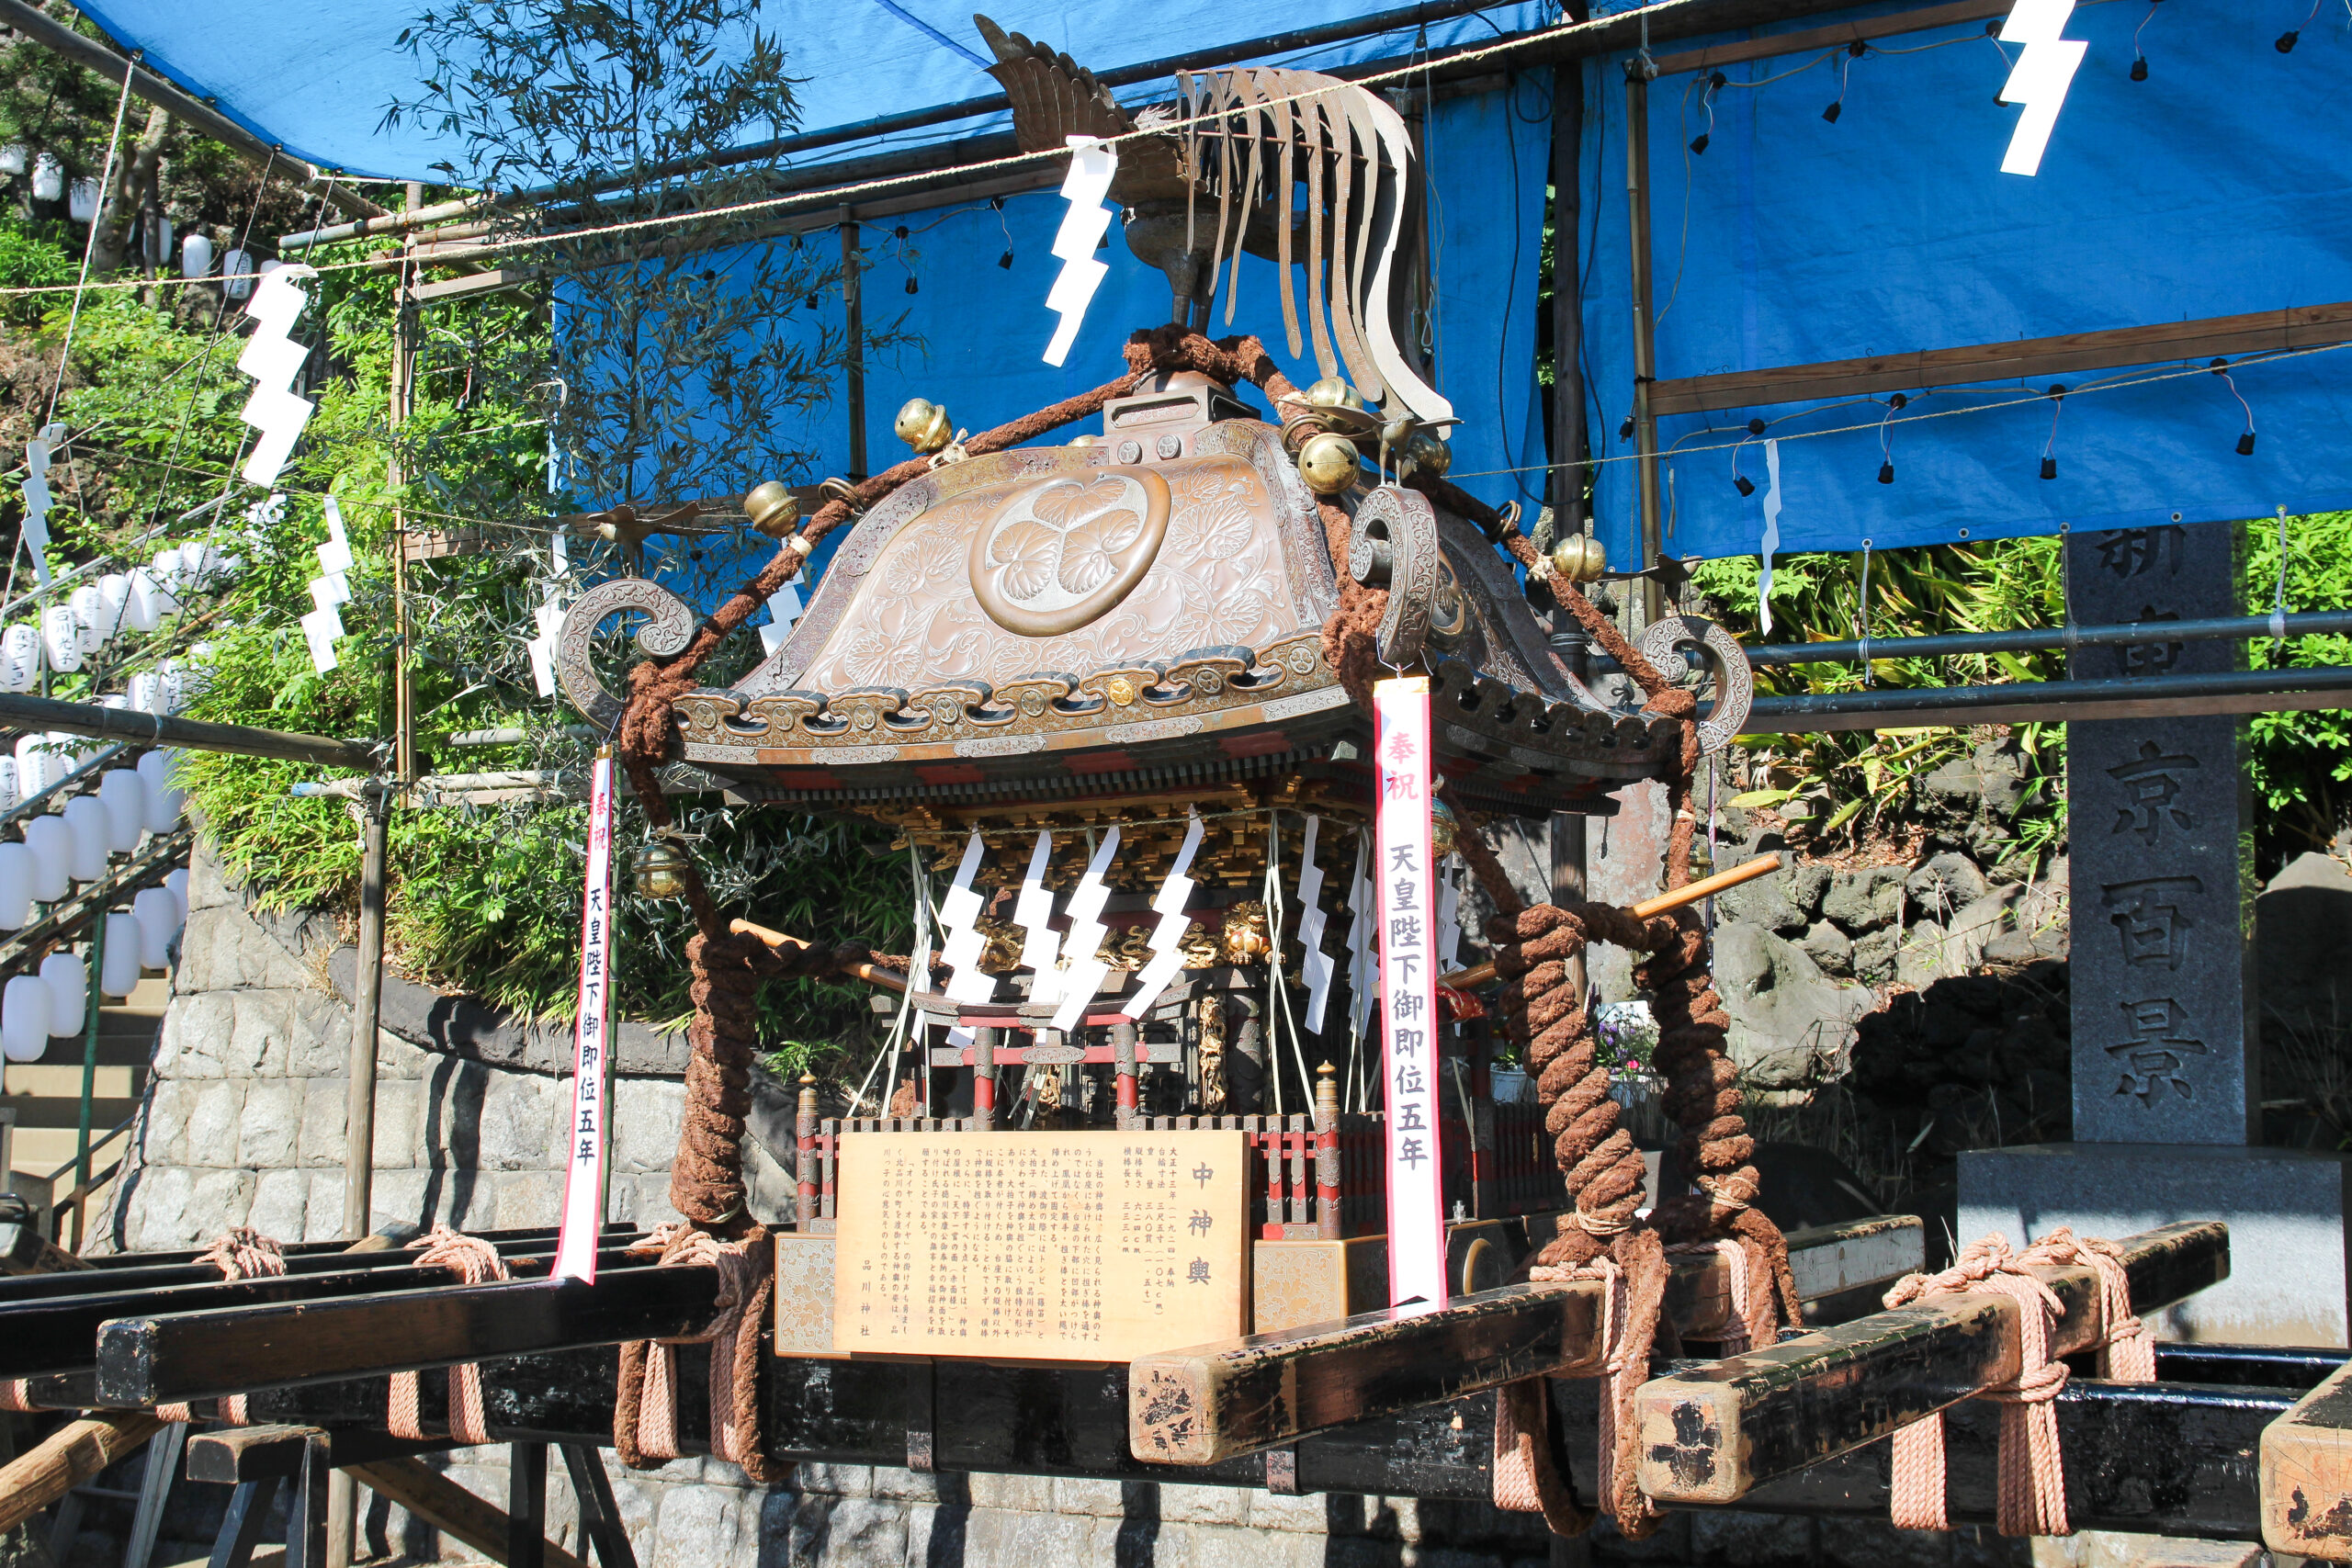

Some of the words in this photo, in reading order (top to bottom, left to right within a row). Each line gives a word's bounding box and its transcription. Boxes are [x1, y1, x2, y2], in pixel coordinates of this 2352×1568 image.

[1386, 732, 1419, 801] 奉祝
[594, 791, 607, 851] 奉祝
[577, 889, 603, 1167] 天皇陛下御即位五年
[1389, 843, 1429, 1170] 天皇陛下御即位五年
[1186, 1161, 1214, 1285] 中神輿
[860, 1260, 872, 1336] 品川神社
